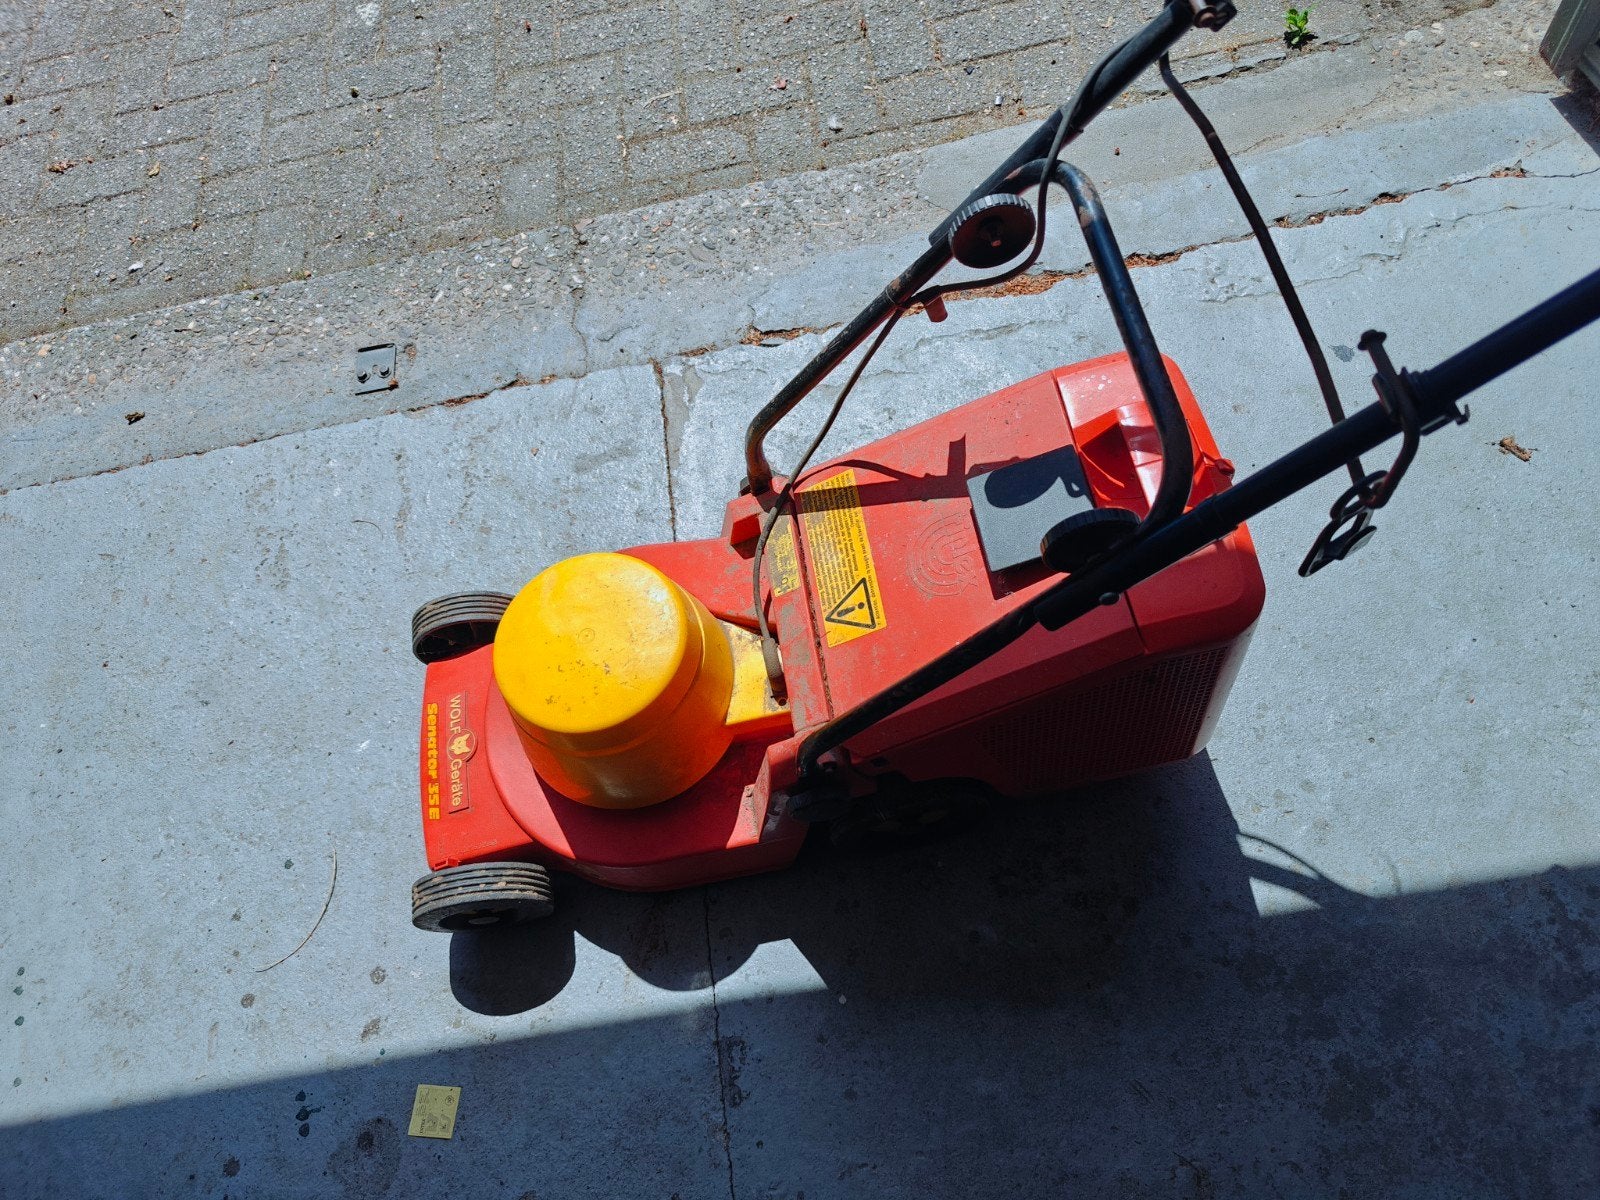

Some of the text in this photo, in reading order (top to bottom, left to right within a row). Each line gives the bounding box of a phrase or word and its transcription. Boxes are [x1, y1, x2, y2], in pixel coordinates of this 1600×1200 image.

[427, 702, 440, 820] Senator 35 E
[450, 694, 463, 806] WOLF Geräte
